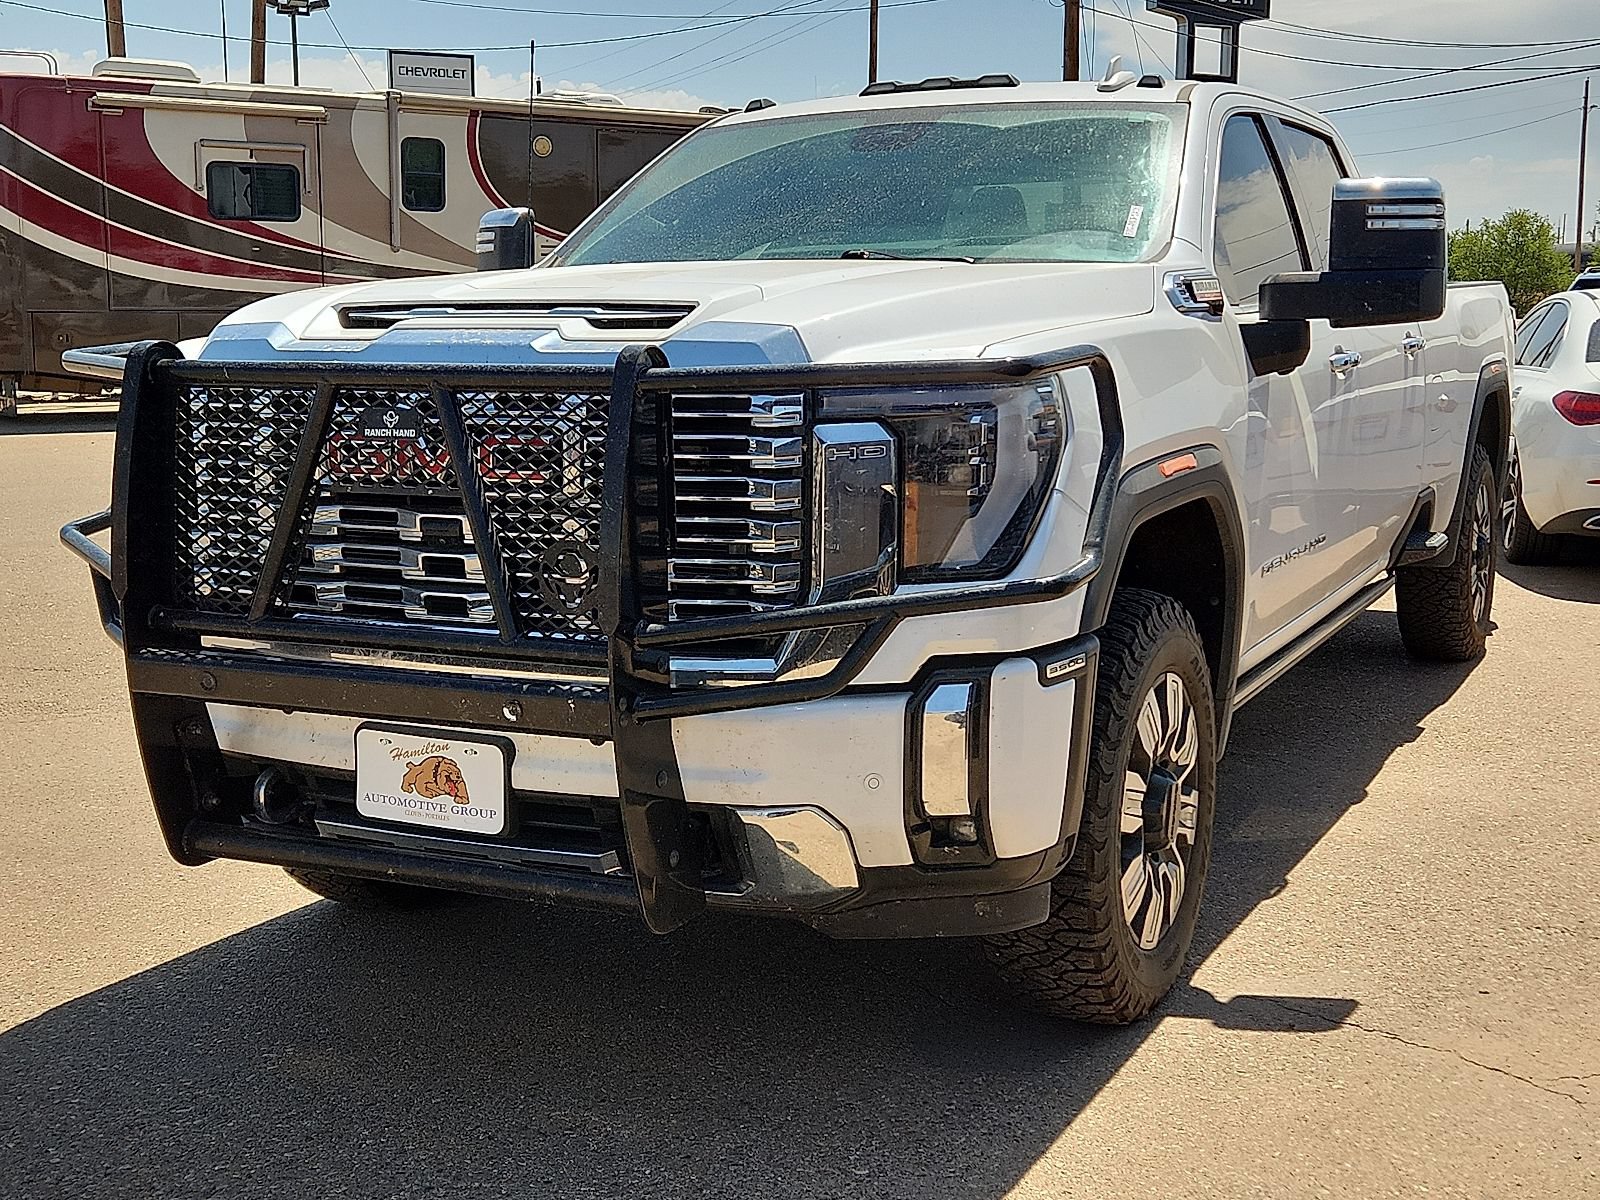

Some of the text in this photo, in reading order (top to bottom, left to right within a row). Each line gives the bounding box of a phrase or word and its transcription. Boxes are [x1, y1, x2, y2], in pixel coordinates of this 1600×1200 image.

[398, 65, 467, 79] CHEVROLET
[364, 428, 416, 438] RANCH HAND
[327, 432, 555, 483] GMC
[828, 445, 887, 461] HD
[1049, 657, 1085, 675] 3500
[389, 741, 451, 761] Hamilton
[363, 792, 497, 819] AUTOMOTIVE GROUP
